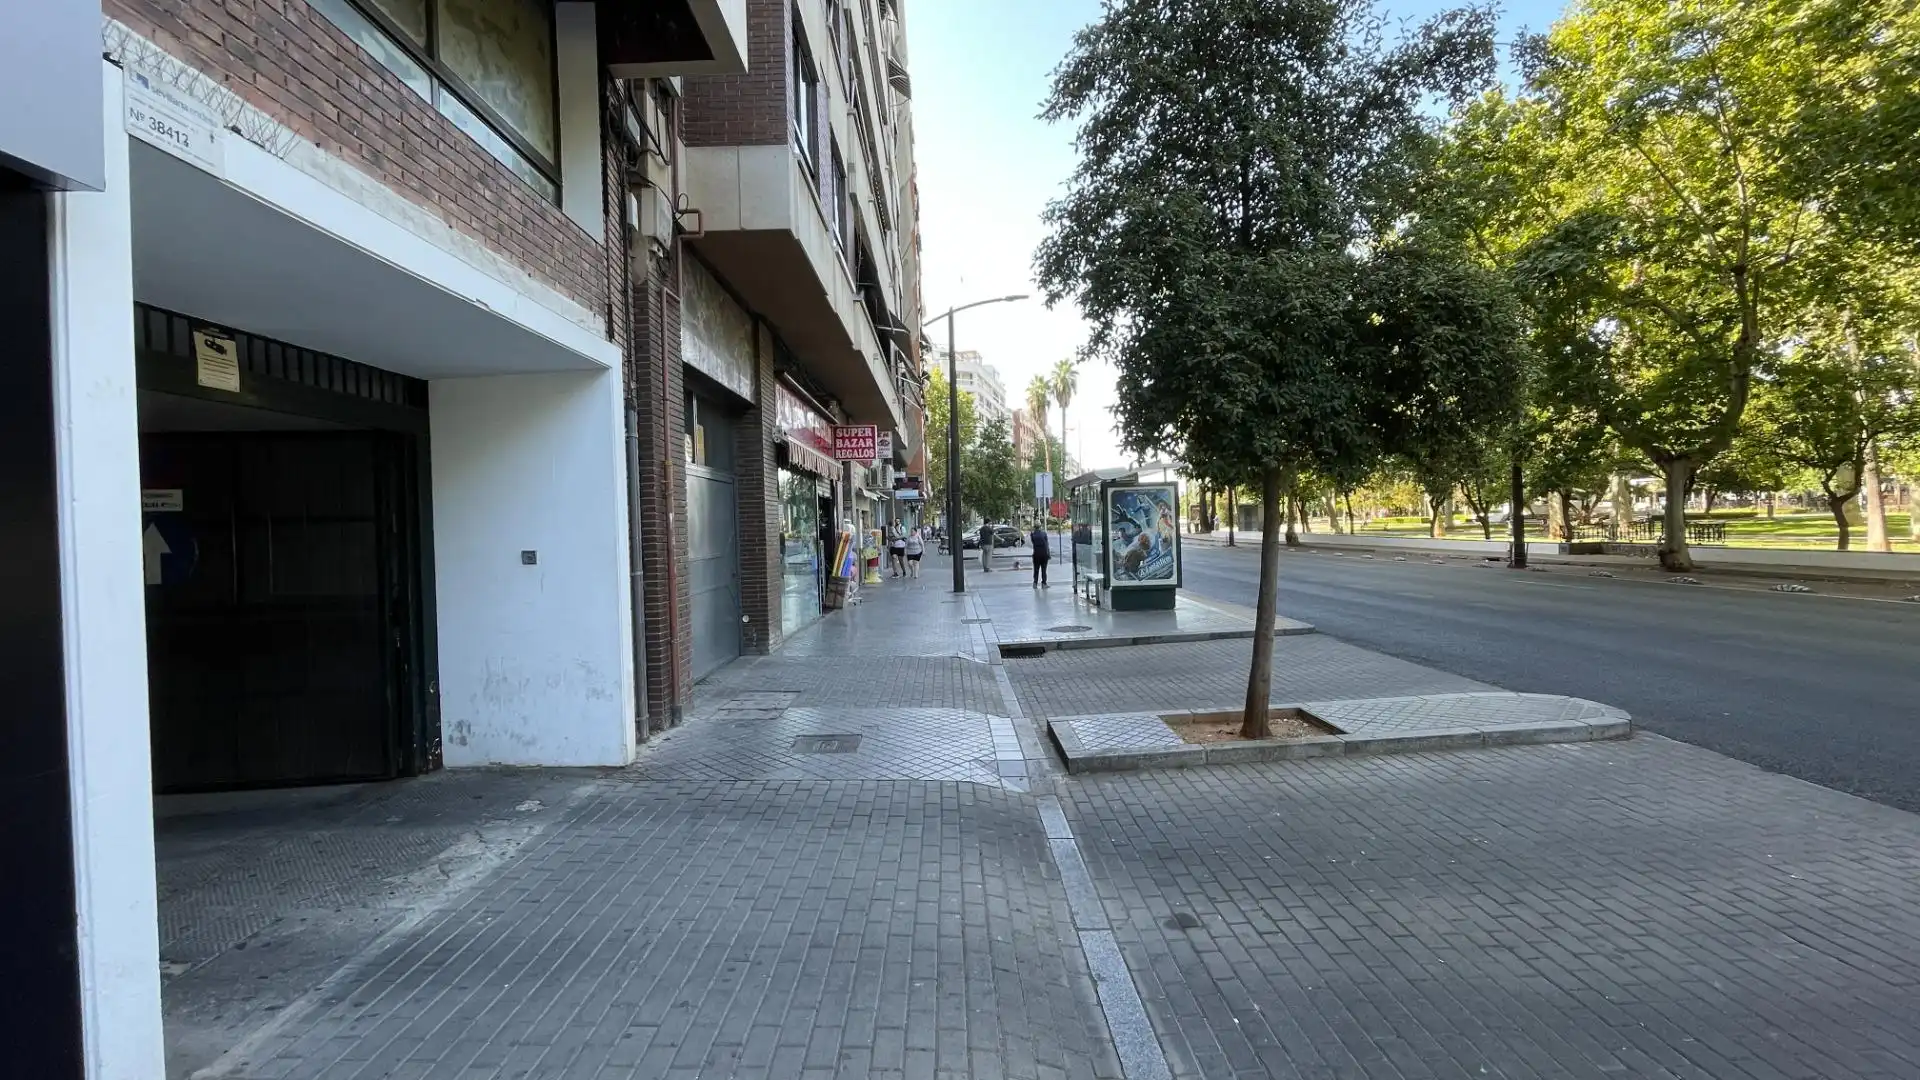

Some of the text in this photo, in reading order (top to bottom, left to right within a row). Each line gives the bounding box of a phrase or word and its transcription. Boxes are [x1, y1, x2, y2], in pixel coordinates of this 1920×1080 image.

[836, 428, 873, 437] SUPER
[836, 438, 874, 448] BAZAR
[836, 448, 875, 458] REGALOS
